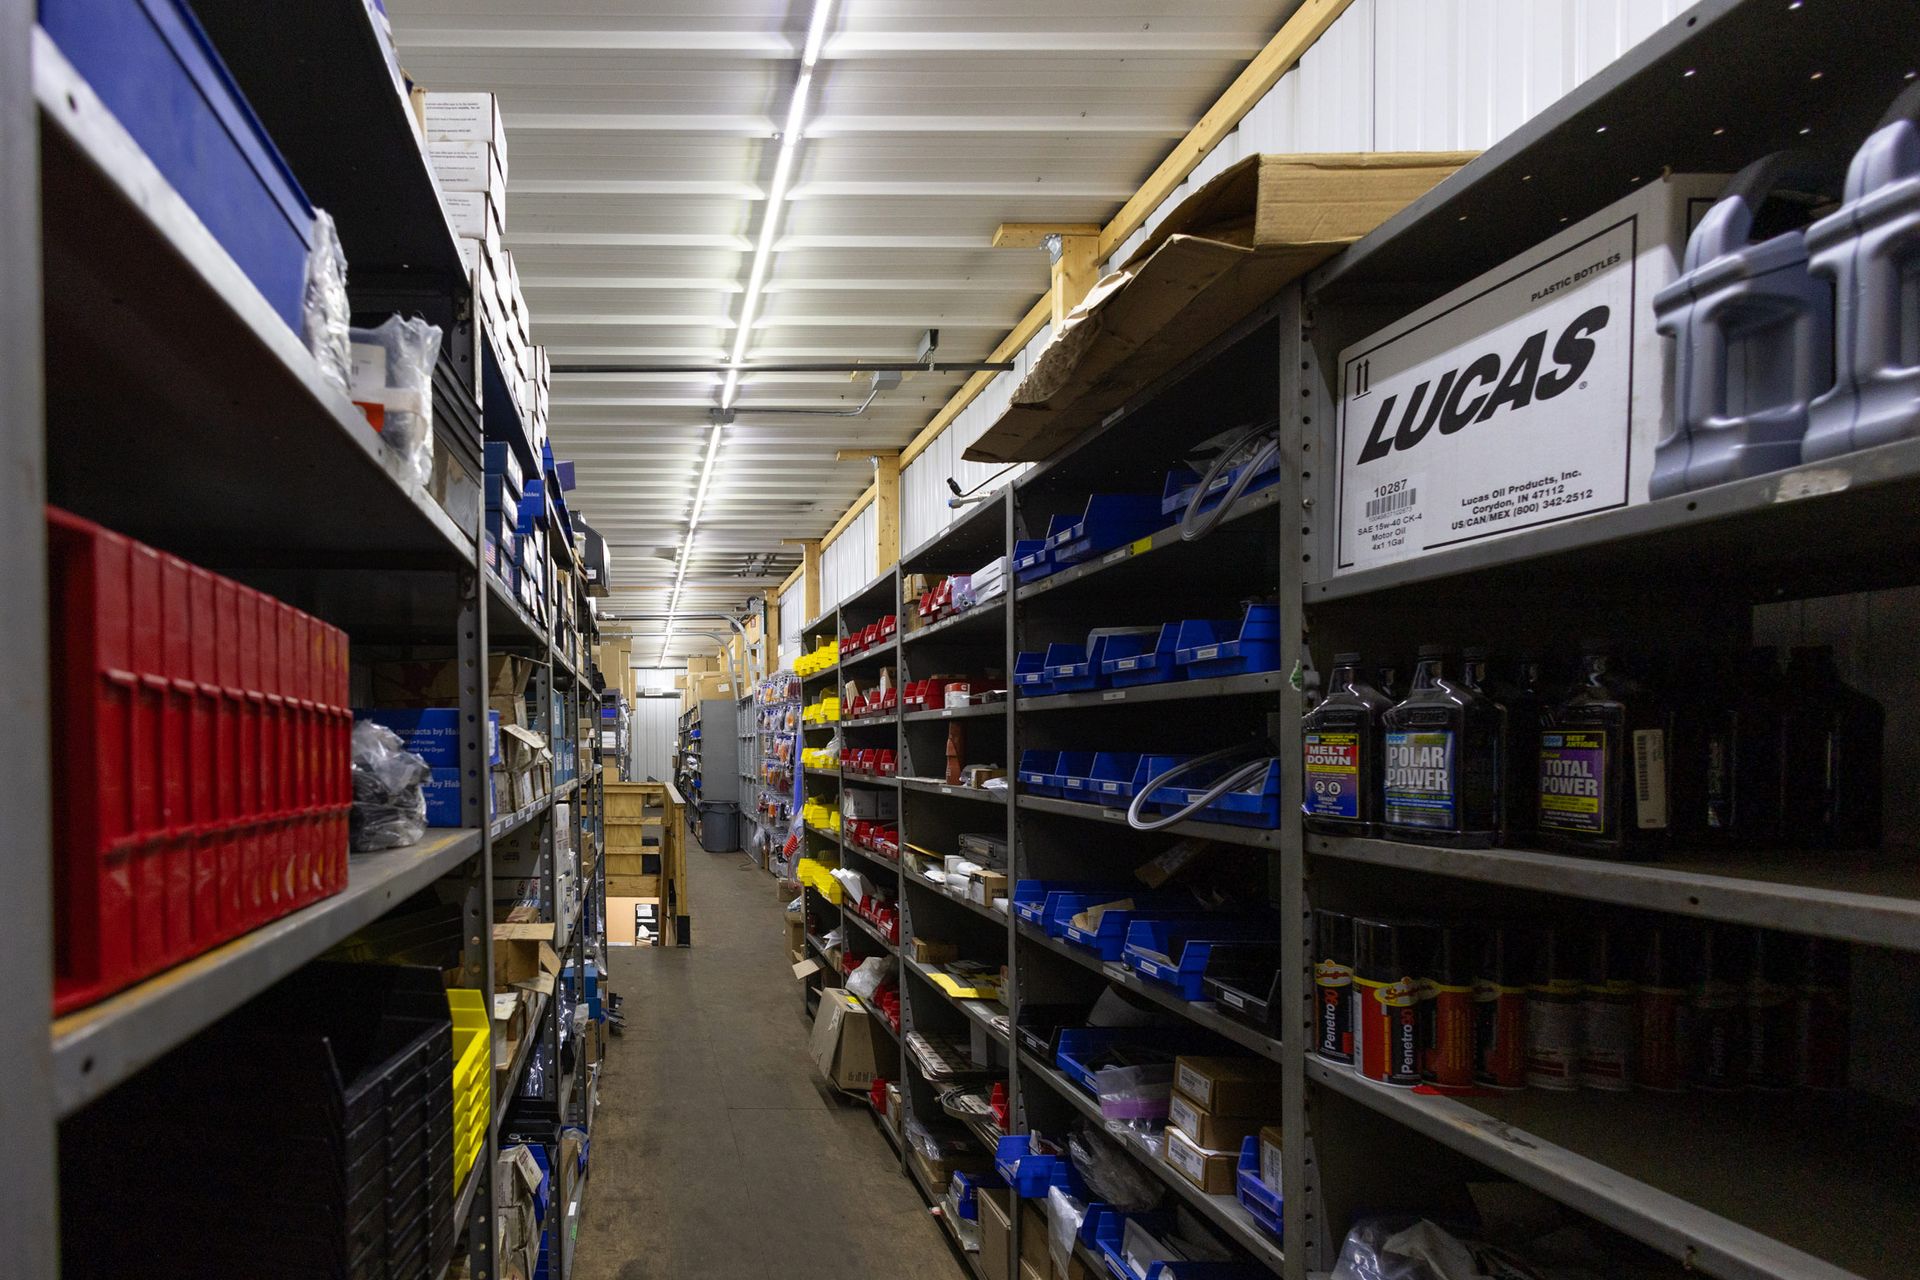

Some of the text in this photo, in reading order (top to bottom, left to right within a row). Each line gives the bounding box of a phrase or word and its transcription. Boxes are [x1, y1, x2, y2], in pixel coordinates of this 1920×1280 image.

[1530, 252, 1621, 302] PLASTIC BOTTLES
[1356, 304, 1611, 466] LUCAS
[1373, 479, 1408, 498] 10287
[1461, 469, 1582, 507] Lucas Oil Products, Inc.
[1472, 484, 1565, 515] Corydon, IN 47112
[1512, 503, 1540, 518] (800)
[1541, 488, 1594, 510] 342-2512
[1357, 512, 1423, 536] SAE 15w-40 CK-4
[1371, 526, 1407, 542] Motor Oil
[1371, 537, 1405, 551] 4x1 1Gal
[1307, 755, 1352, 766] DOWN
[1309, 744, 1347, 756] MELT
[1388, 746, 1445, 768] POLAR
[1386, 768, 1449, 791] POWER
[1544, 759, 1594, 778] TOTAL
[1541, 776, 1599, 796] POWER
